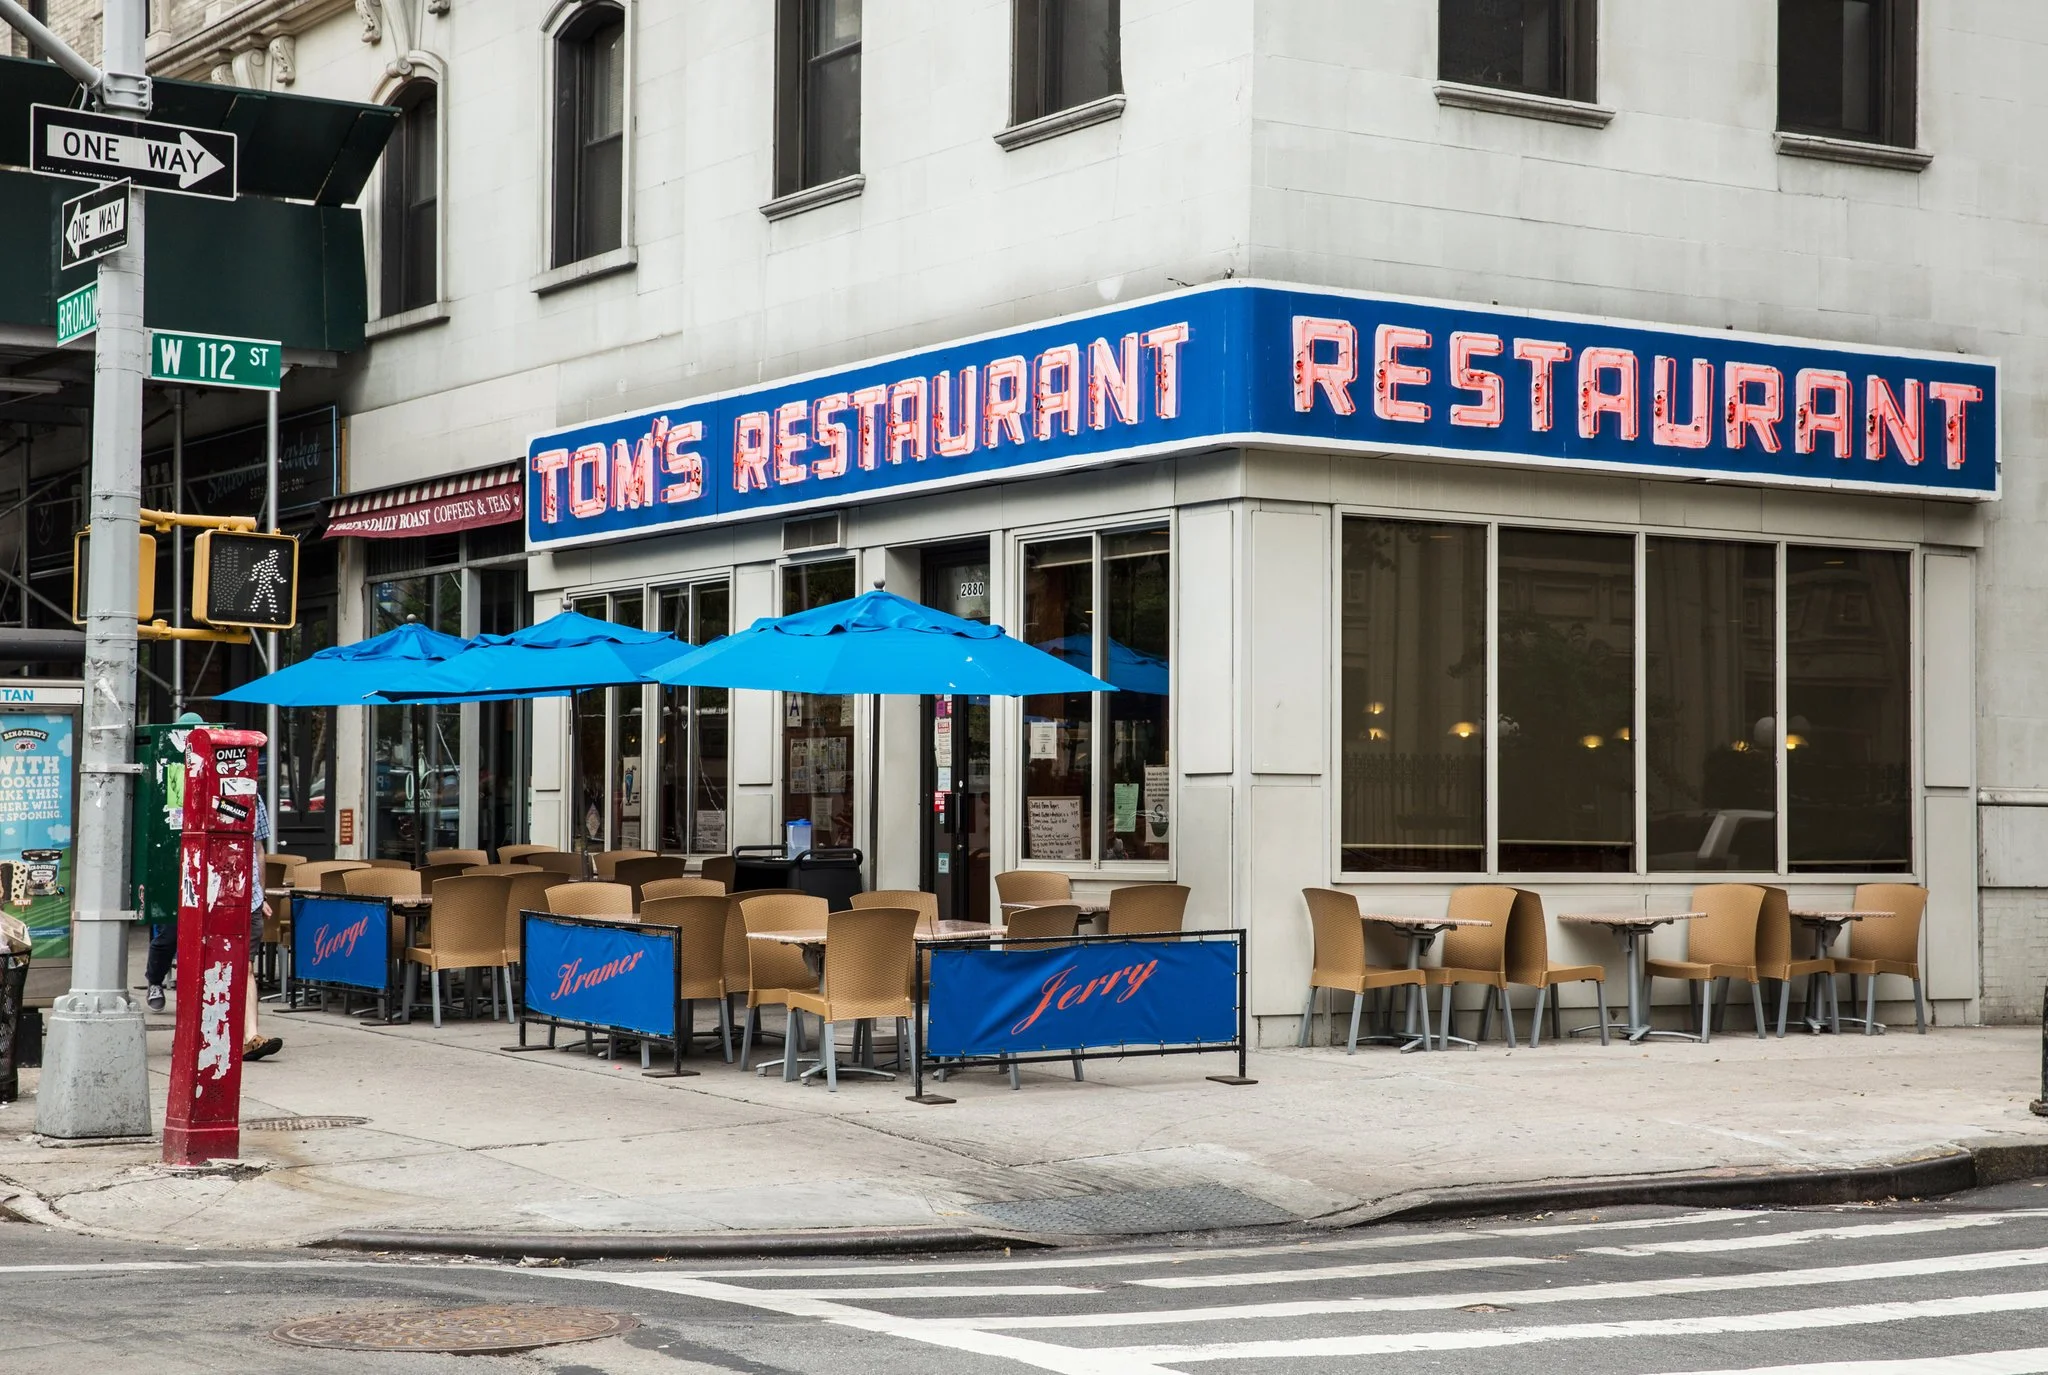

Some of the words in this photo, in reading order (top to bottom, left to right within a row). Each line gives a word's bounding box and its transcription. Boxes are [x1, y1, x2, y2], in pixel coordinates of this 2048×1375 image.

[63, 131, 120, 163] ONE
[147, 144, 205, 174] WAY
[71, 170, 119, 180] TRANSPORTATION
[72, 214, 91, 244] ONE
[98, 203, 121, 234] WAY
[160, 337, 183, 375] W
[197, 342, 236, 380] 112
[249, 346, 269, 367] ST
[1291, 314, 1983, 471] RESTAURANT
[532, 416, 703, 524] TOM'S
[732, 322, 1190, 494] RESTAURANT
[278, 429, 321, 472] arket
[367, 514, 399, 532] DAILY
[399, 508, 430, 531] ROAST
[433, 501, 476, 523] COFFEES
[477, 498, 487, 515] &
[486, 493, 511, 514] TEAS
[961, 582, 984, 597] 2880
[0, 688, 34, 701] TAN
[789, 693, 800, 716] A
[216, 748, 246, 760] ONLY.
[26, 788, 63, 800] THIS.
[32, 800, 60, 811] WILL
[7, 810, 63, 822] SPOONING.
[312, 914, 369, 966] George
[550, 949, 645, 1001] Kramer
[1010, 958, 1159, 1036] Jerry
